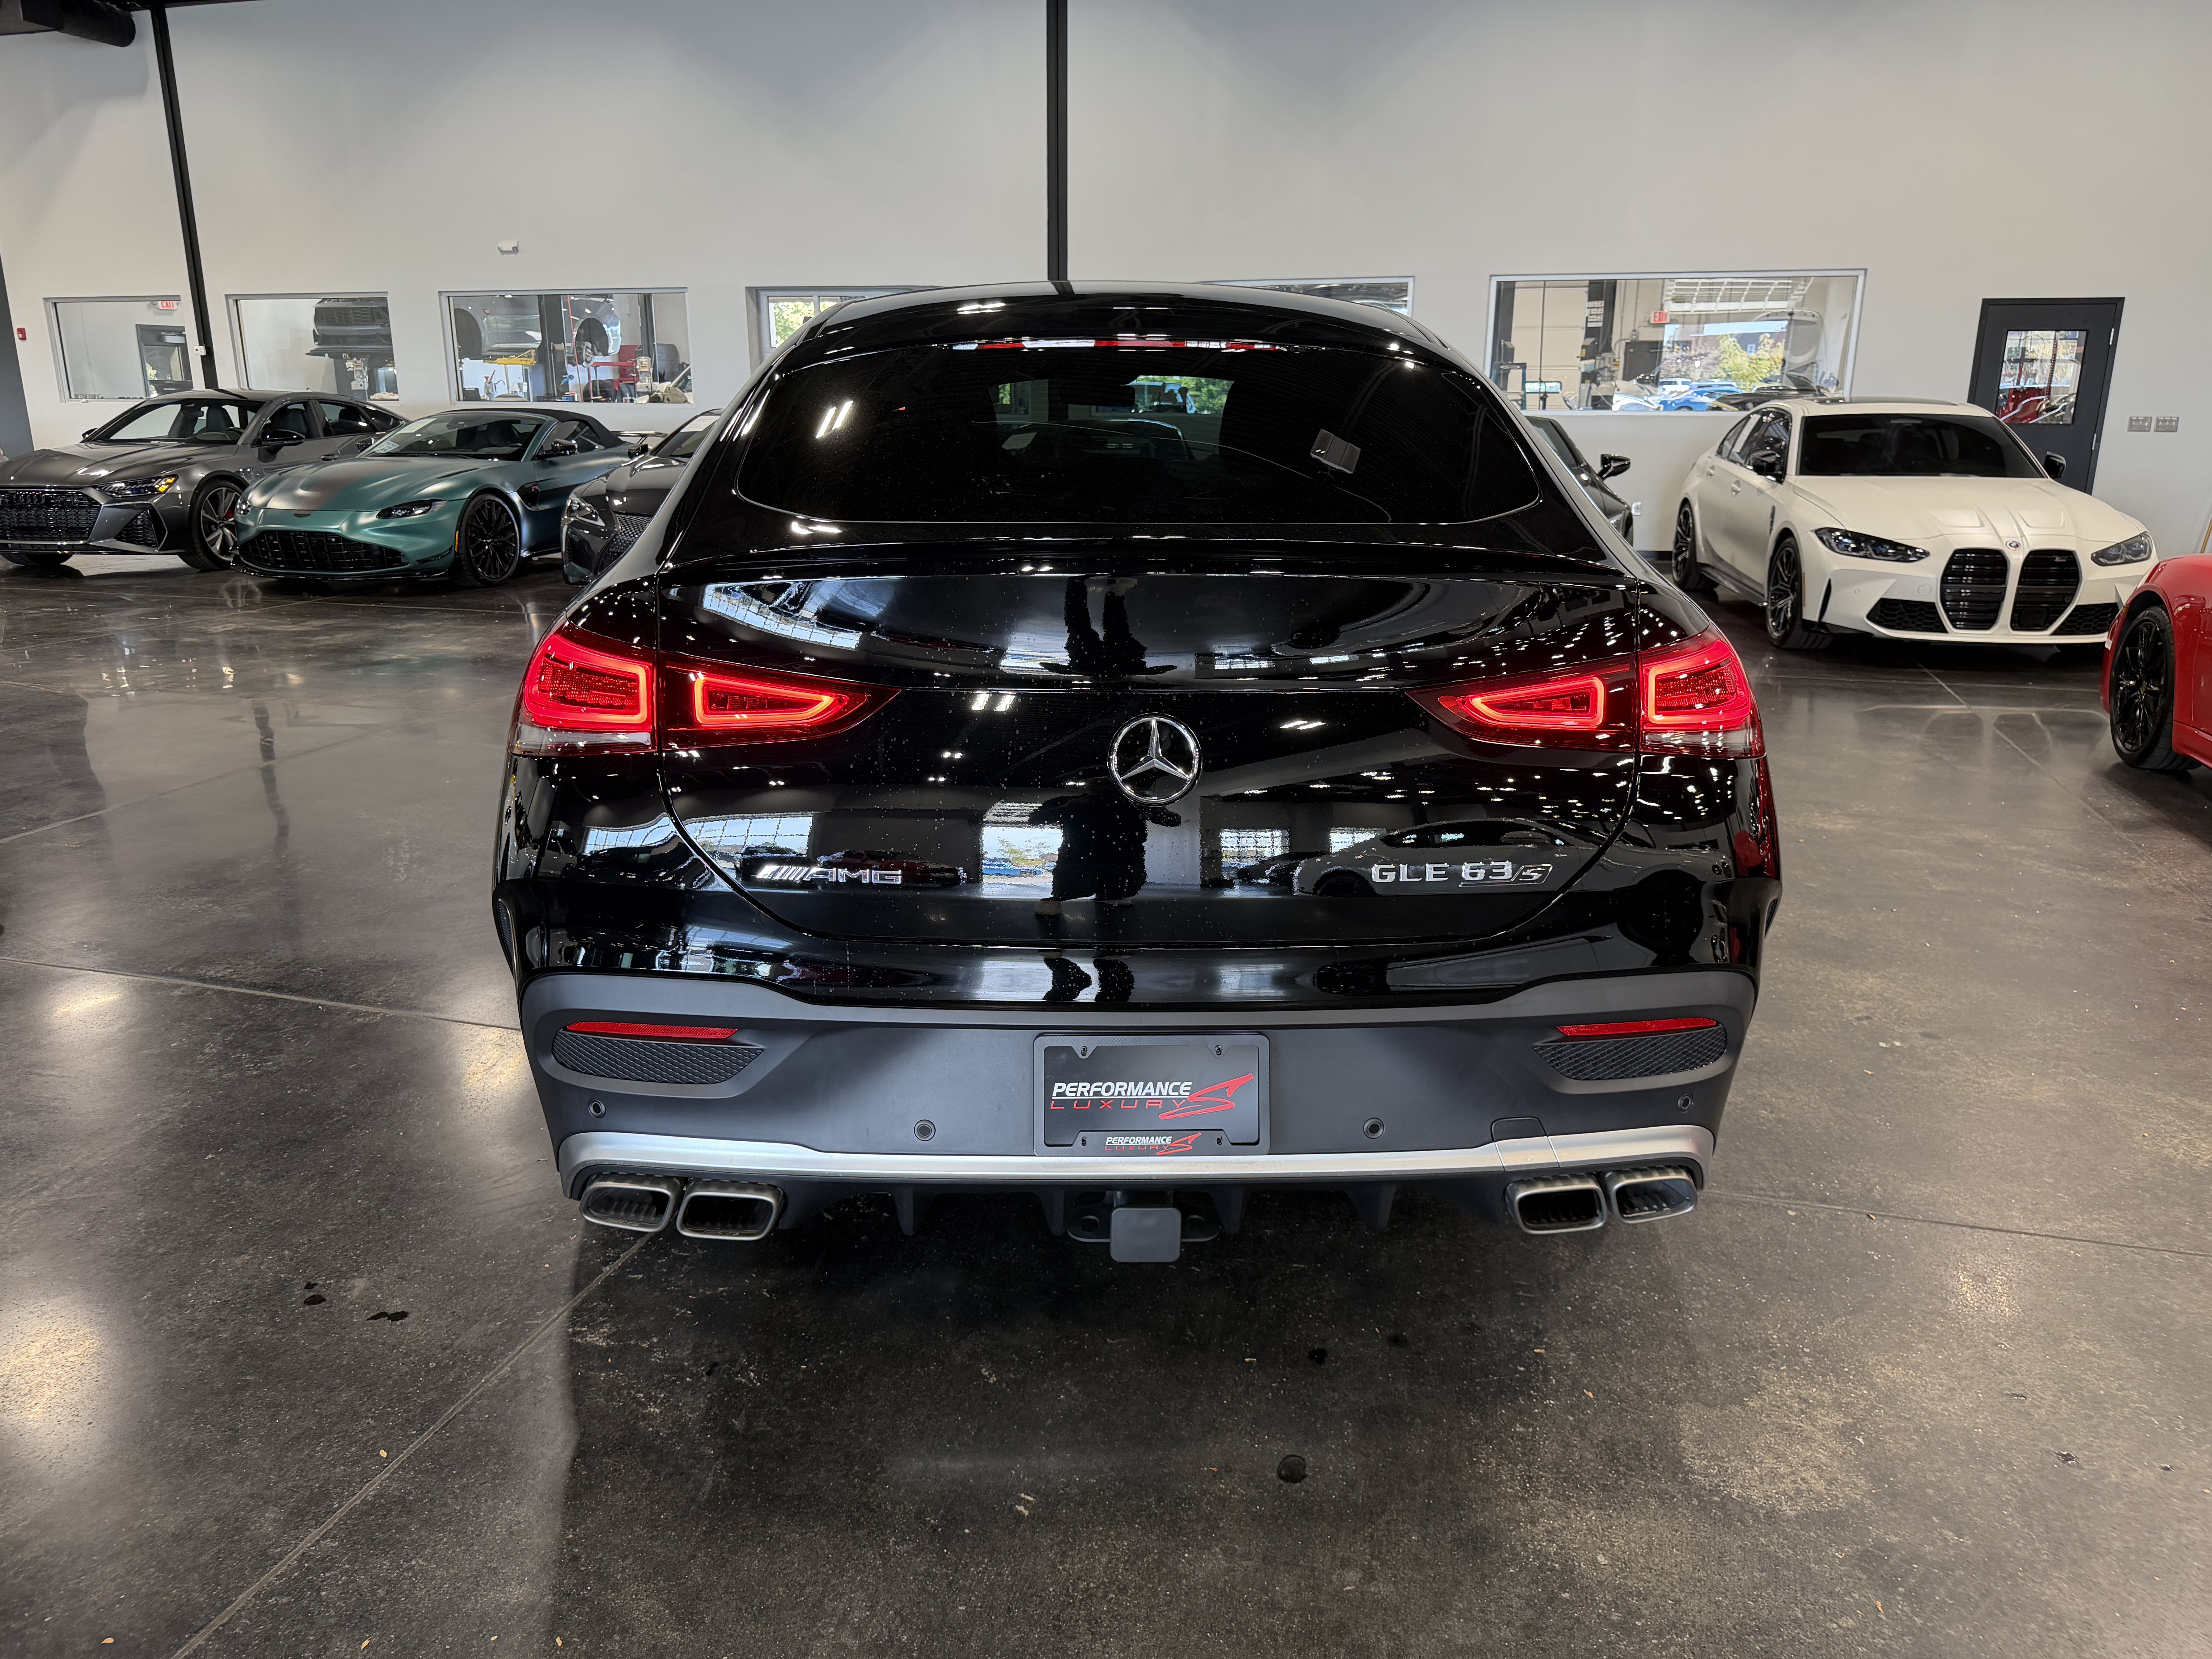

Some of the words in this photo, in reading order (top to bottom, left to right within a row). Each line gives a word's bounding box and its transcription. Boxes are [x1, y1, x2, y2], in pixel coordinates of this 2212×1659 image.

[1653, 311, 1668, 323] EXIT
[804, 867, 902, 884] AMG
[1372, 864, 1449, 883] GLE
[1052, 1081, 1192, 1097] PERFORMANCE
[1050, 1099, 1186, 1110] LUXURY
[1106, 1136, 1173, 1144] PERFORMANCE
